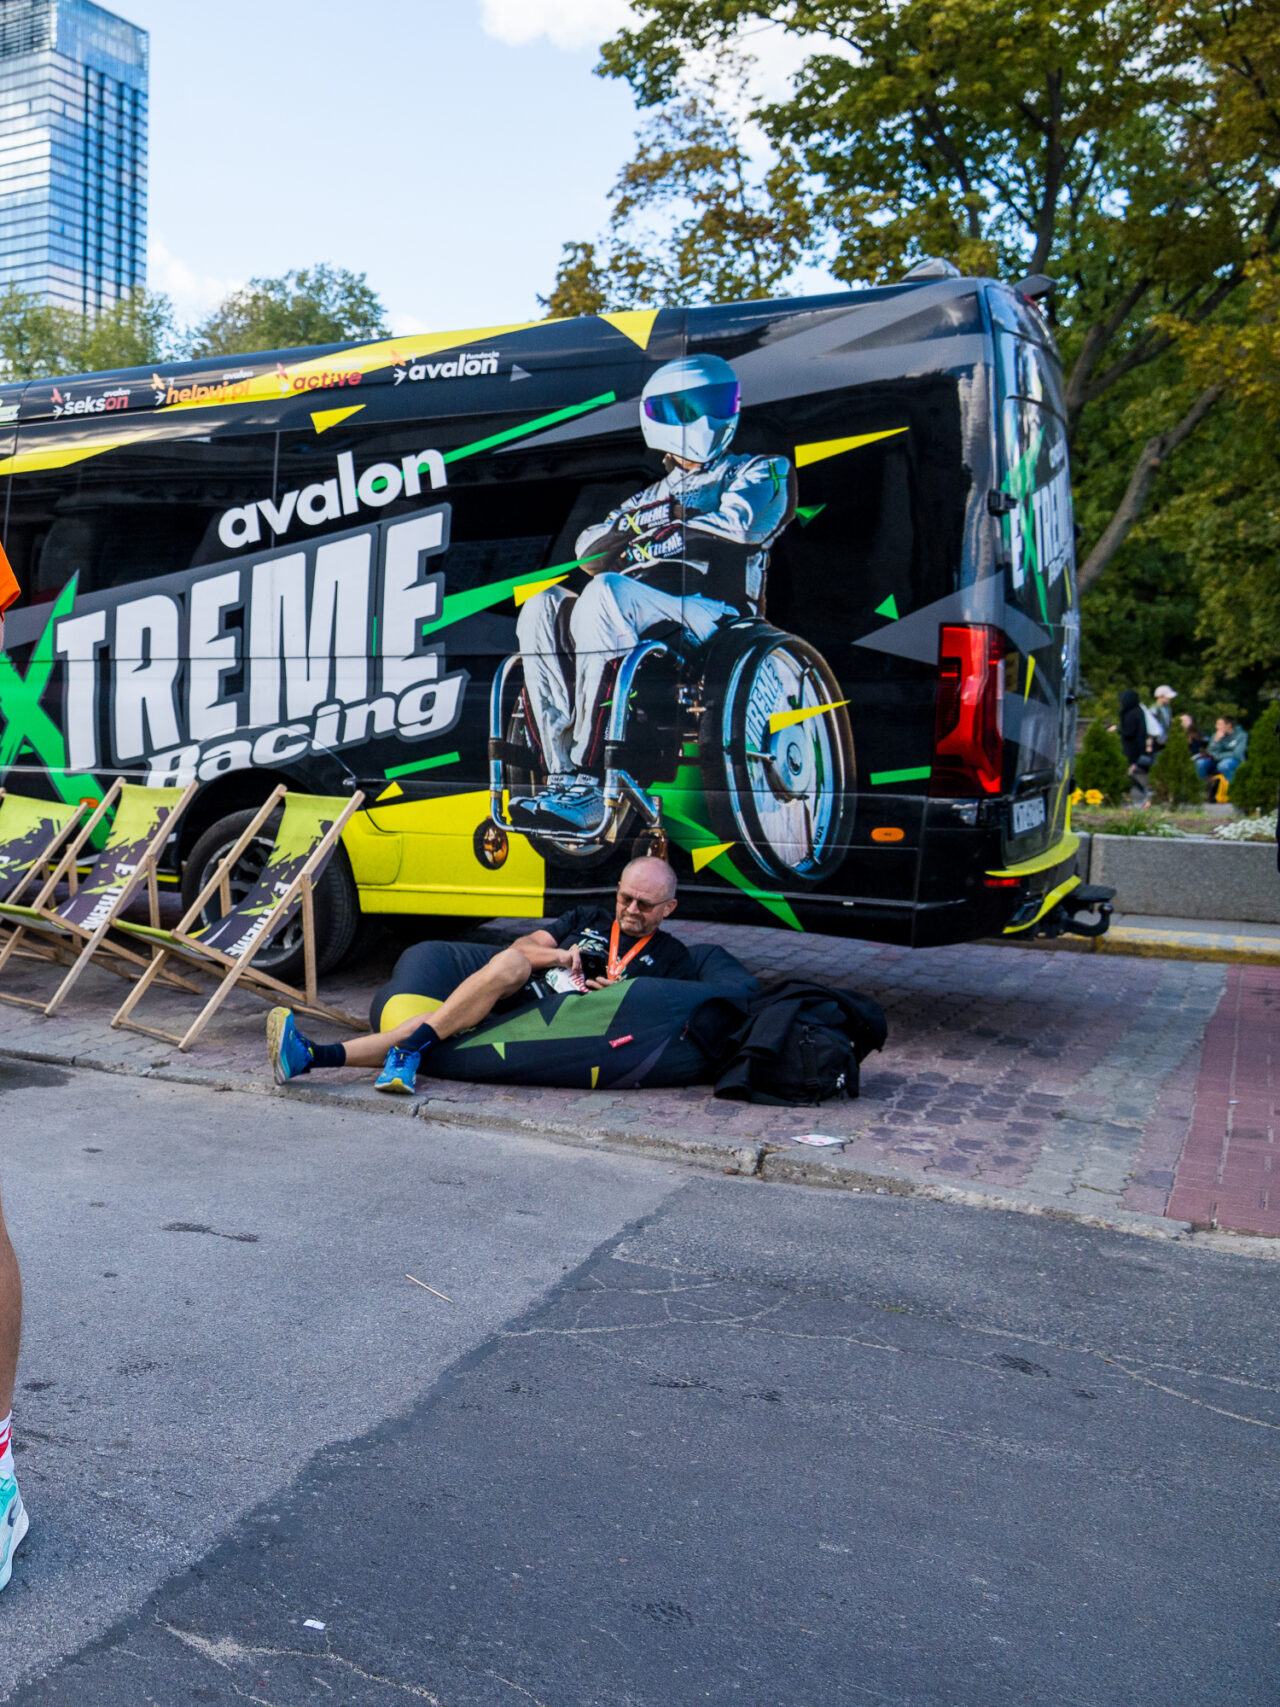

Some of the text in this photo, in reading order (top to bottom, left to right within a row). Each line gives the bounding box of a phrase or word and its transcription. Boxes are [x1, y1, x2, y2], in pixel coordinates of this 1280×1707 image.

[292, 371, 363, 391] active
[408, 353, 499, 381] avalon
[165, 379, 252, 404] helpuj.pl
[218, 448, 448, 548] avalon
[145, 675, 466, 788] Racing
